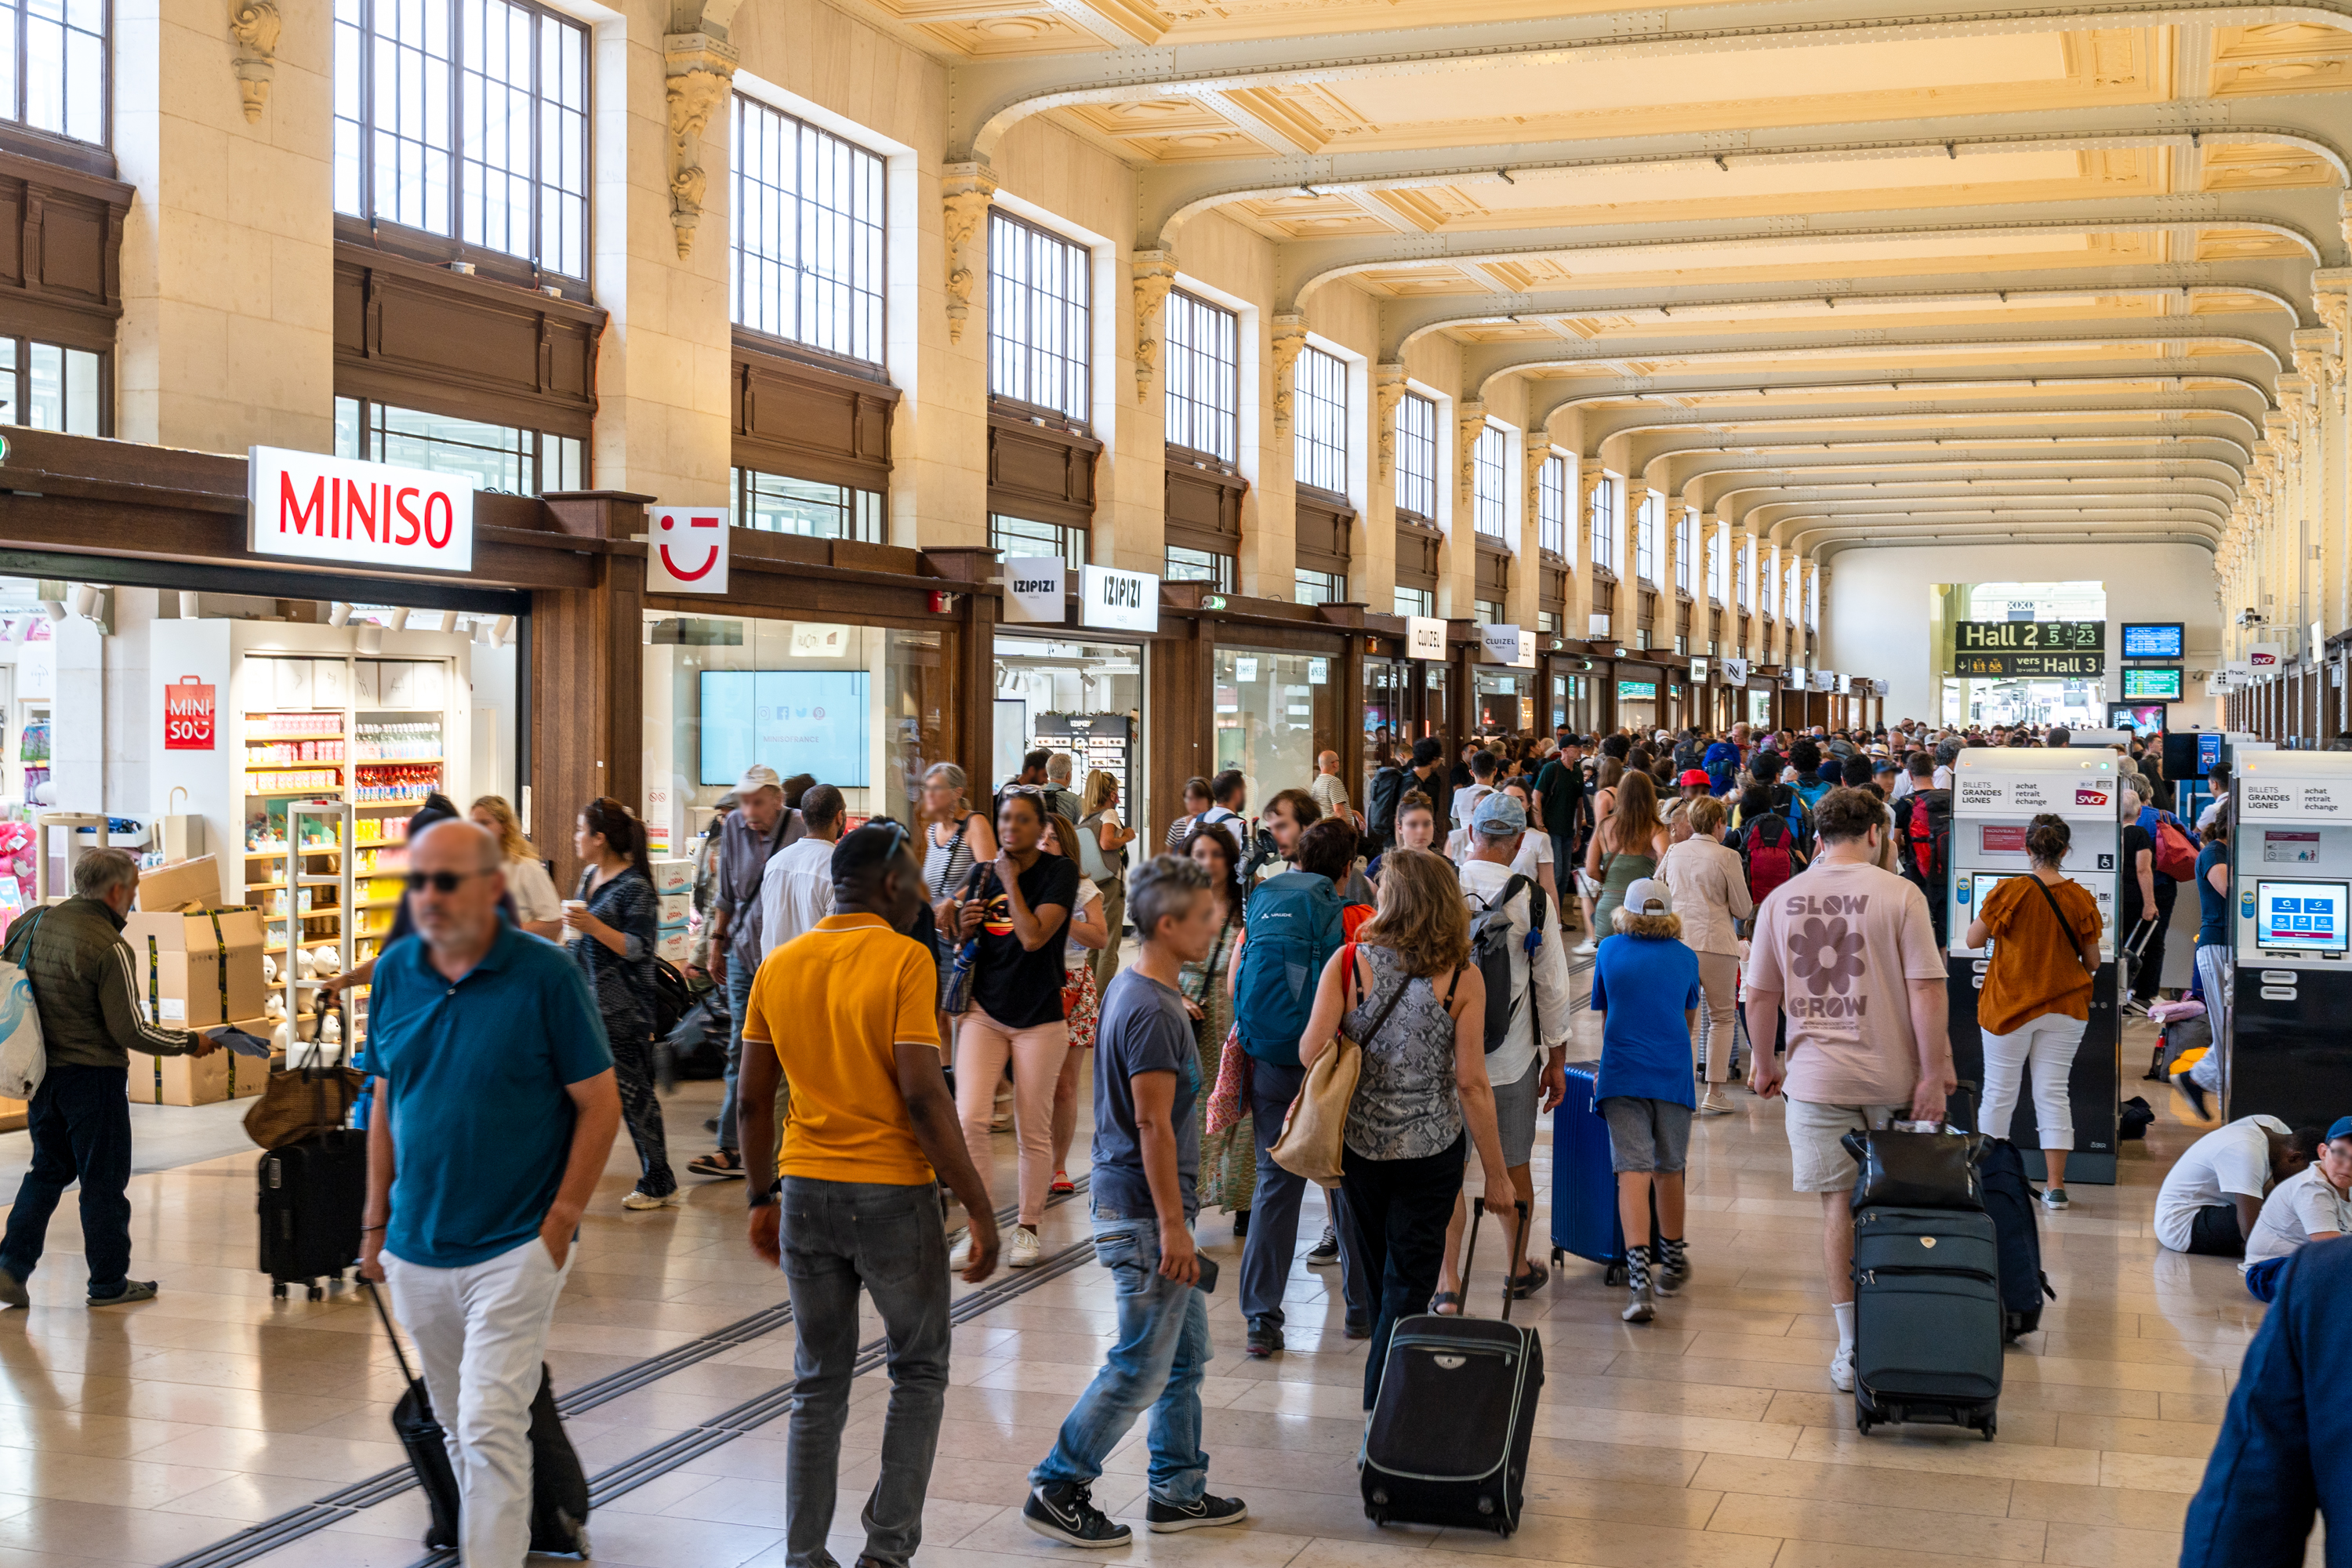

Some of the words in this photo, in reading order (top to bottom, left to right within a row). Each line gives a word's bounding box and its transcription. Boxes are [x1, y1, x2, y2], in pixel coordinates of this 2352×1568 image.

[280, 470, 452, 549] MINISO
[1014, 580, 1054, 593] IZIPIZI
[1103, 575, 1141, 608] IZIPIZI
[1417, 629, 1439, 648] CLUIZEL
[1965, 625, 2017, 647] Hall
[2024, 625, 2038, 647] 2
[2049, 630, 2060, 643] 5
[2067, 628, 2072, 637] à
[2077, 630, 2096, 643] 23
[2044, 658, 2081, 673] Hall
[2085, 658, 2096, 673] 3
[2252, 656, 2274, 665] SNCF
[170, 699, 209, 716] MINI
[170, 720, 193, 739] SO
[2077, 795, 2107, 804] SNCF
[1785, 895, 1870, 916] SLOW
[1789, 995, 1868, 1018] GROW
